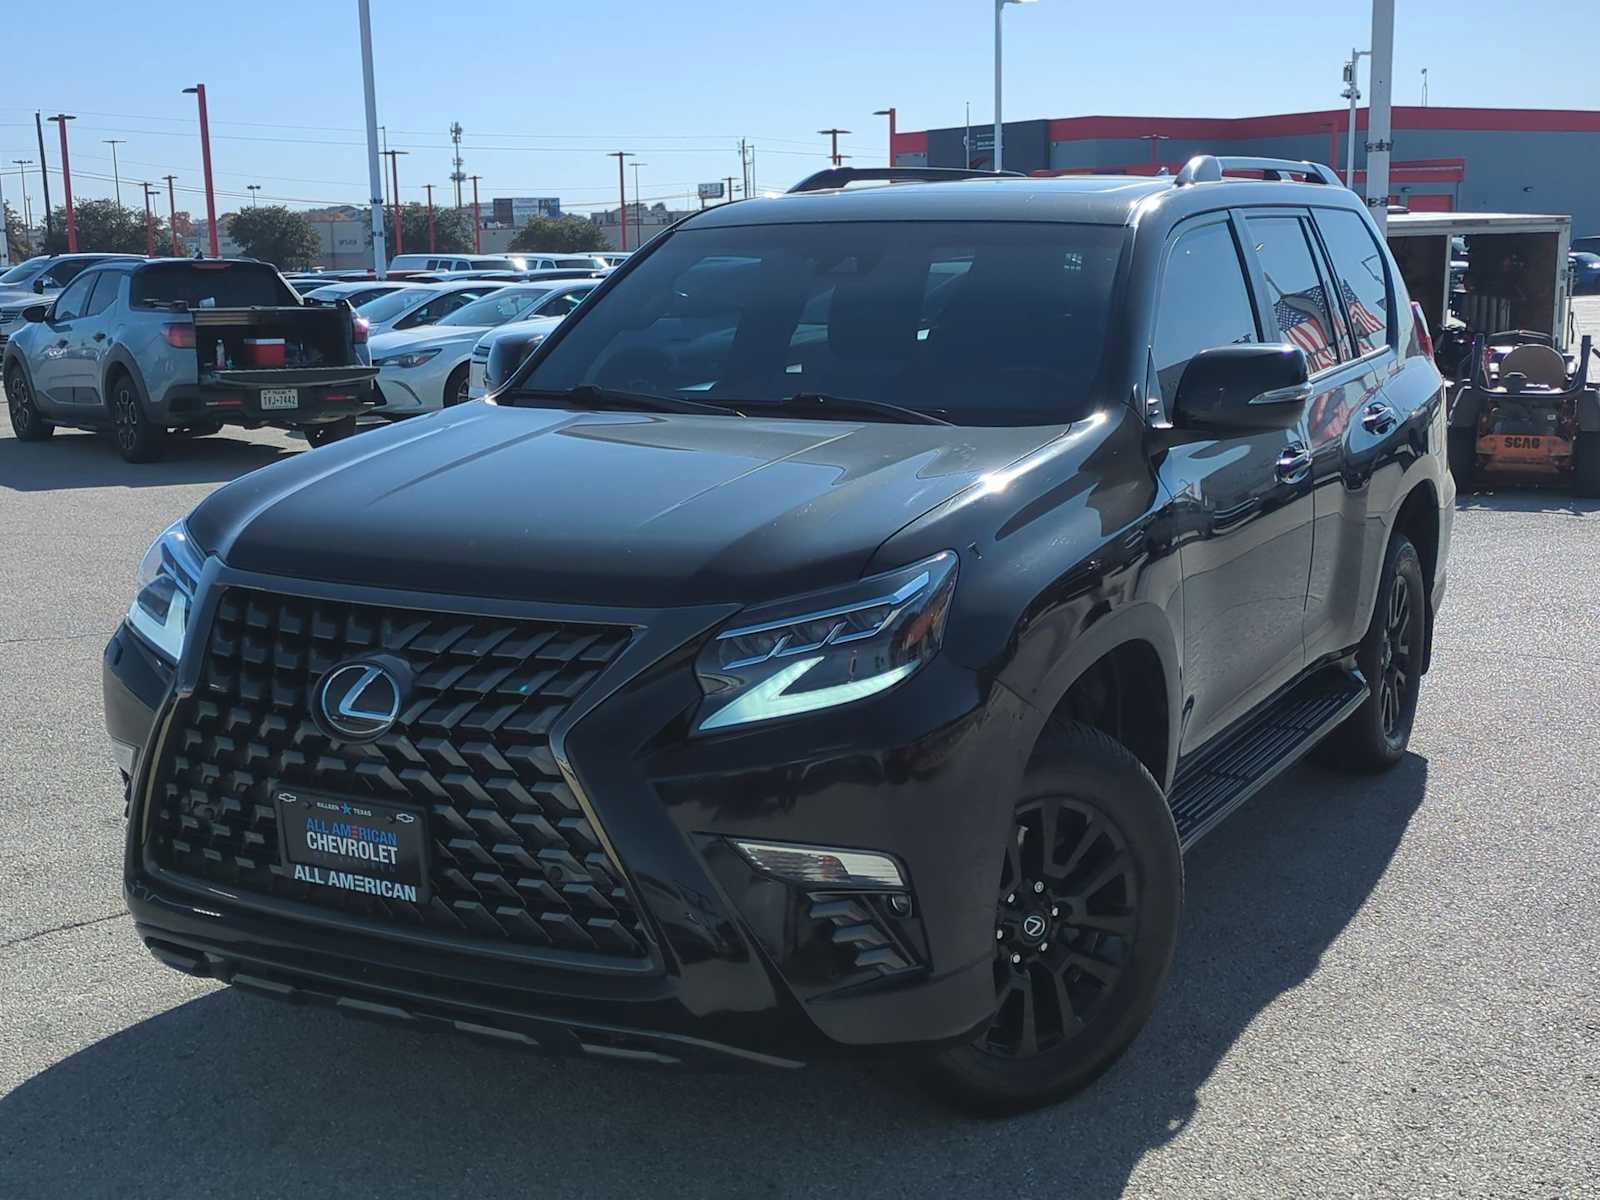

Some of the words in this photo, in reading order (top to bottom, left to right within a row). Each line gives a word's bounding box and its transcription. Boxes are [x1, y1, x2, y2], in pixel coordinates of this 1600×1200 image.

[353, 808, 373, 817] TEXAS
[305, 816, 330, 834] ALL
[332, 822, 398, 846] AMERICAN
[306, 831, 399, 865] CHEVROLET
[294, 864, 325, 885] ALL
[328, 870, 418, 903] AMERICAN
